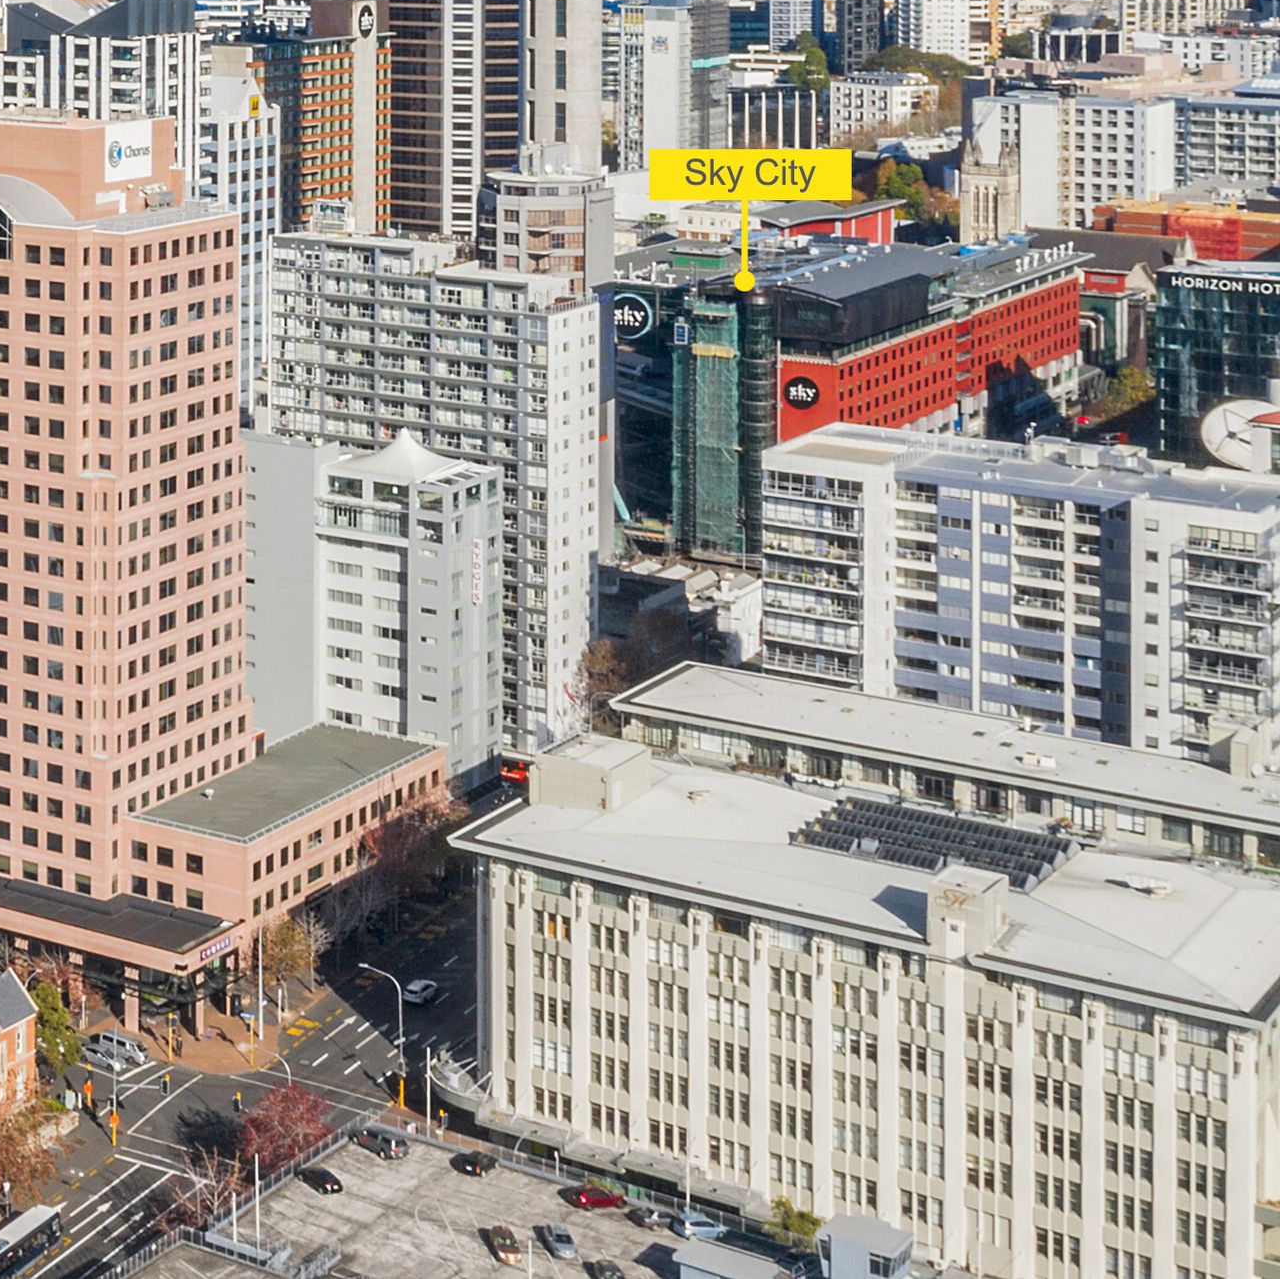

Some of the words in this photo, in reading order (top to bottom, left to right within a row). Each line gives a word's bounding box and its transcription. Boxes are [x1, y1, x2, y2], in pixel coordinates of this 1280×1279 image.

[124, 145, 151, 158] Chorus
[1171, 276, 1243, 292] HORIZON
[472, 542, 481, 601] RYDGES
